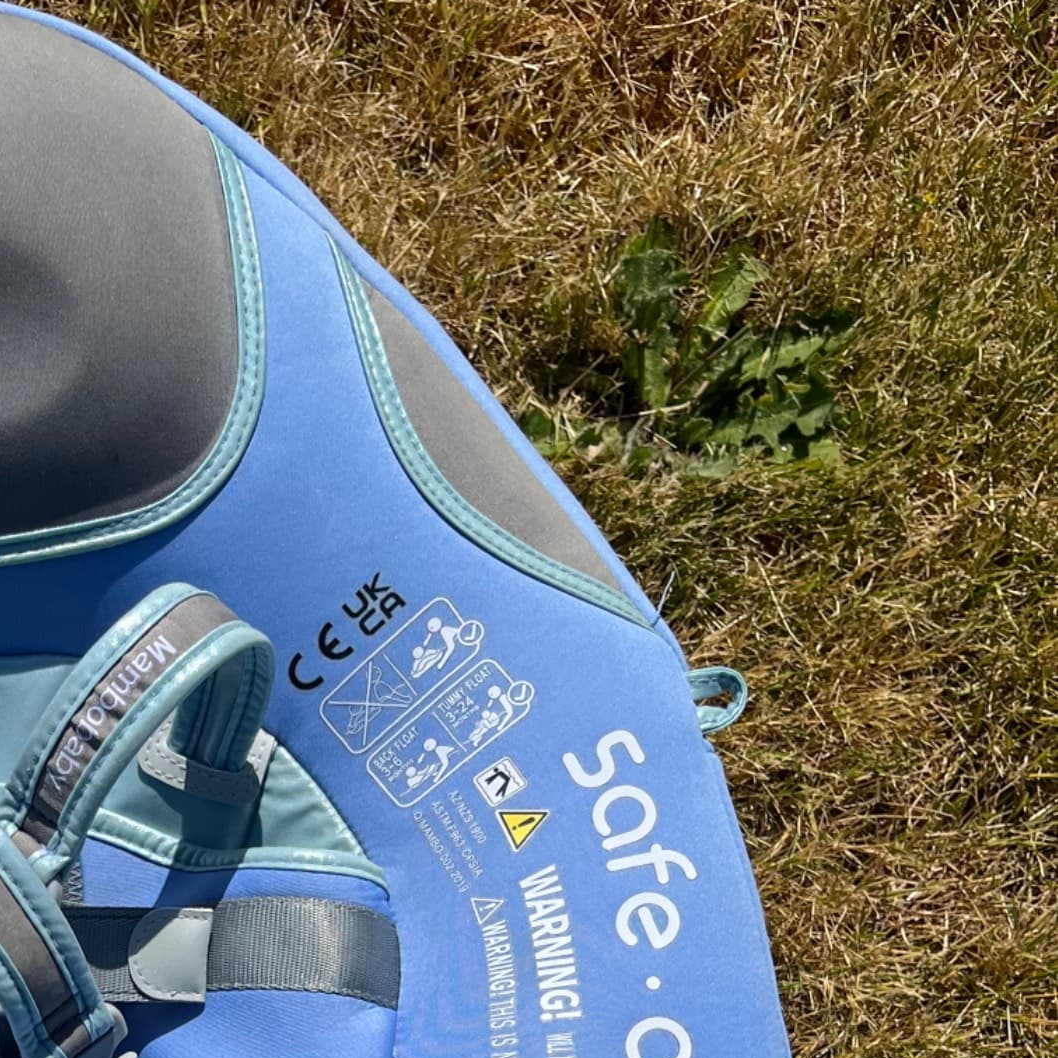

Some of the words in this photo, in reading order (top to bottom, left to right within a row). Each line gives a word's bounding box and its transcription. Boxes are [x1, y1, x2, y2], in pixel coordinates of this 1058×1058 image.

[288, 621, 354, 691] CE
[437, 682, 468, 713] TUMMY
[465, 666, 493, 692] FLOAT
[446, 696, 475, 723] 3-24
[373, 746, 397, 768] BACK
[394, 726, 419, 751] FLOAT
[380, 755, 403, 777] 3-6
[482, 920, 516, 998] WARNING!
[519, 864, 583, 1022] WARNING!
[488, 997, 517, 1030] THIS
[490, 1032, 518, 1048] IS
[546, 1032, 574, 1054] WILL
